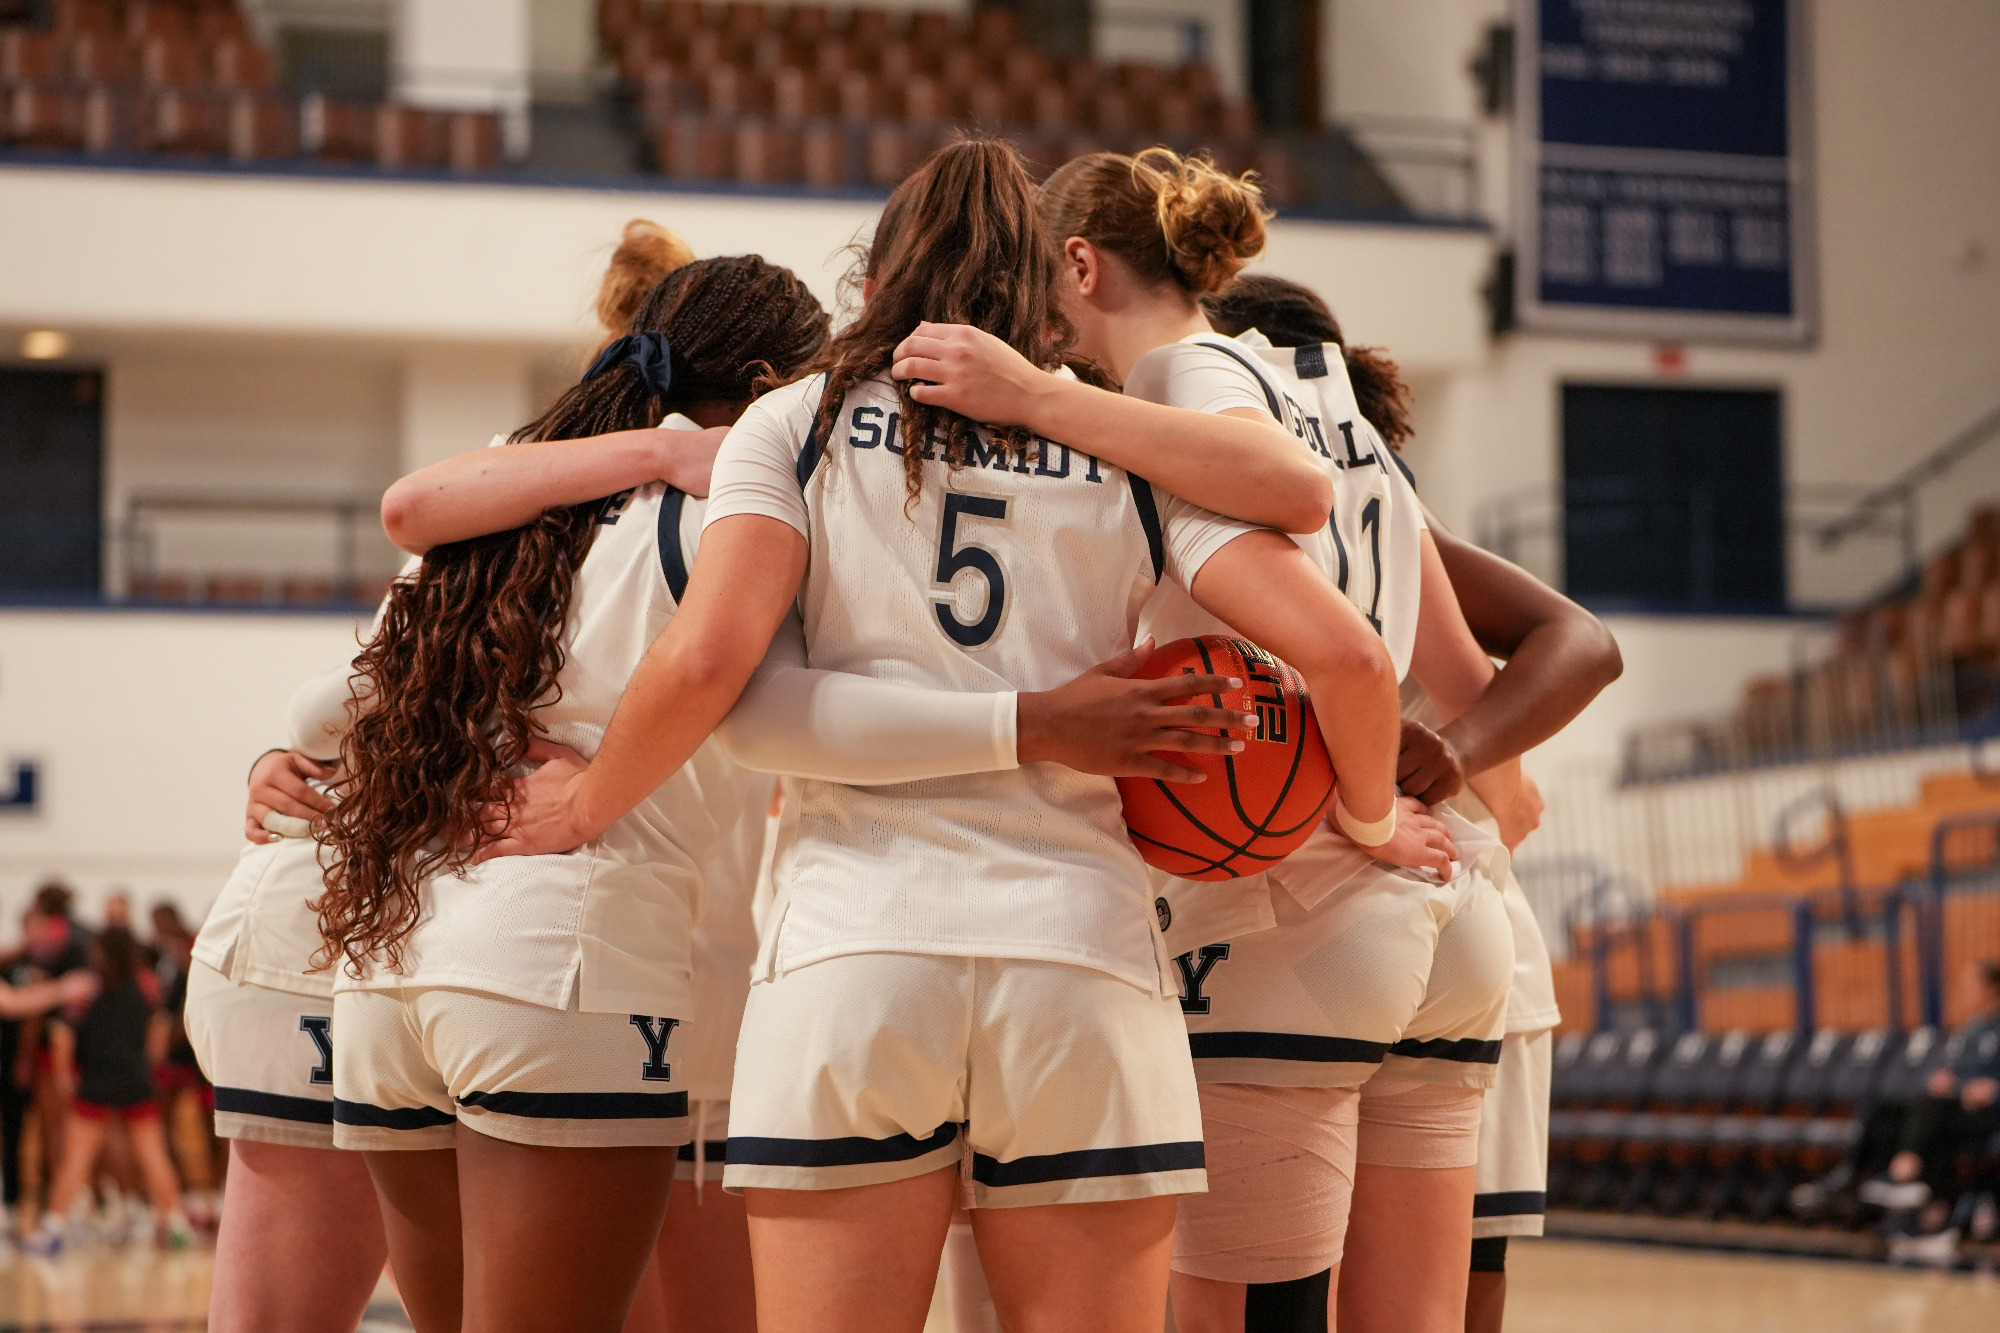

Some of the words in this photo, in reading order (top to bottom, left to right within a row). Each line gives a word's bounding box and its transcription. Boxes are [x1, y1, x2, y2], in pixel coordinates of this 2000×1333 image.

[929, 488, 1014, 649] 5
[1171, 943, 1230, 1014] Y
[630, 1014, 679, 1082] Y
